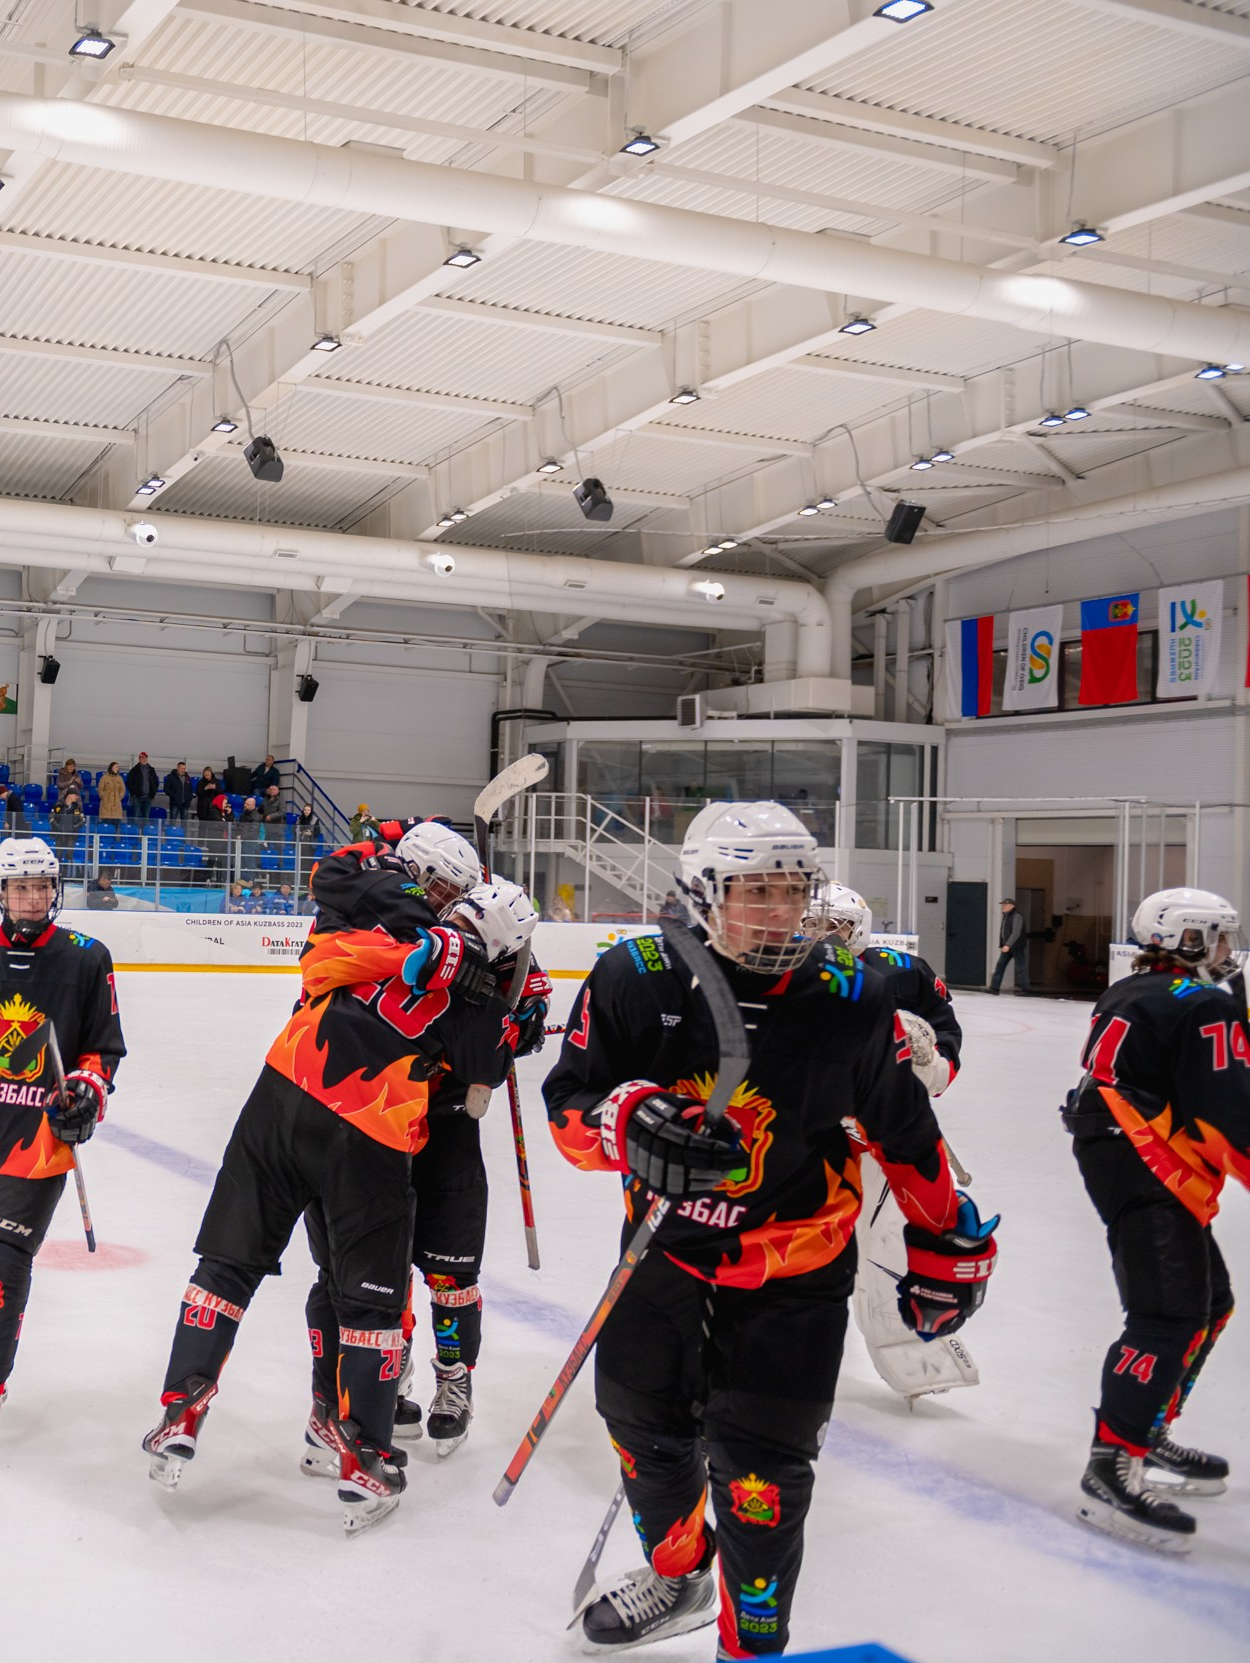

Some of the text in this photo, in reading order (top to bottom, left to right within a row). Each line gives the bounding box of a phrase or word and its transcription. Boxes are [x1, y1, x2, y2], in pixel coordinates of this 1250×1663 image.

[1178, 638, 1192, 681] 2023
[186, 918, 222, 926] CHILDREN
[636, 938, 663, 972] 2023
[1199, 1020, 1250, 1071] 74
[424, 1250, 476, 1262] TRUE
[360, 1282, 395, 1294] BAUER
[184, 1305, 218, 1331] 20
[340, 1327, 382, 1348] УЗБАСС
[438, 1350, 461, 1359] 2023
[1113, 1345, 1158, 1384] 74
[150, 1422, 188, 1451] CCM
[350, 1469, 390, 1498] CCM
[740, 1618, 778, 1634] 2023
